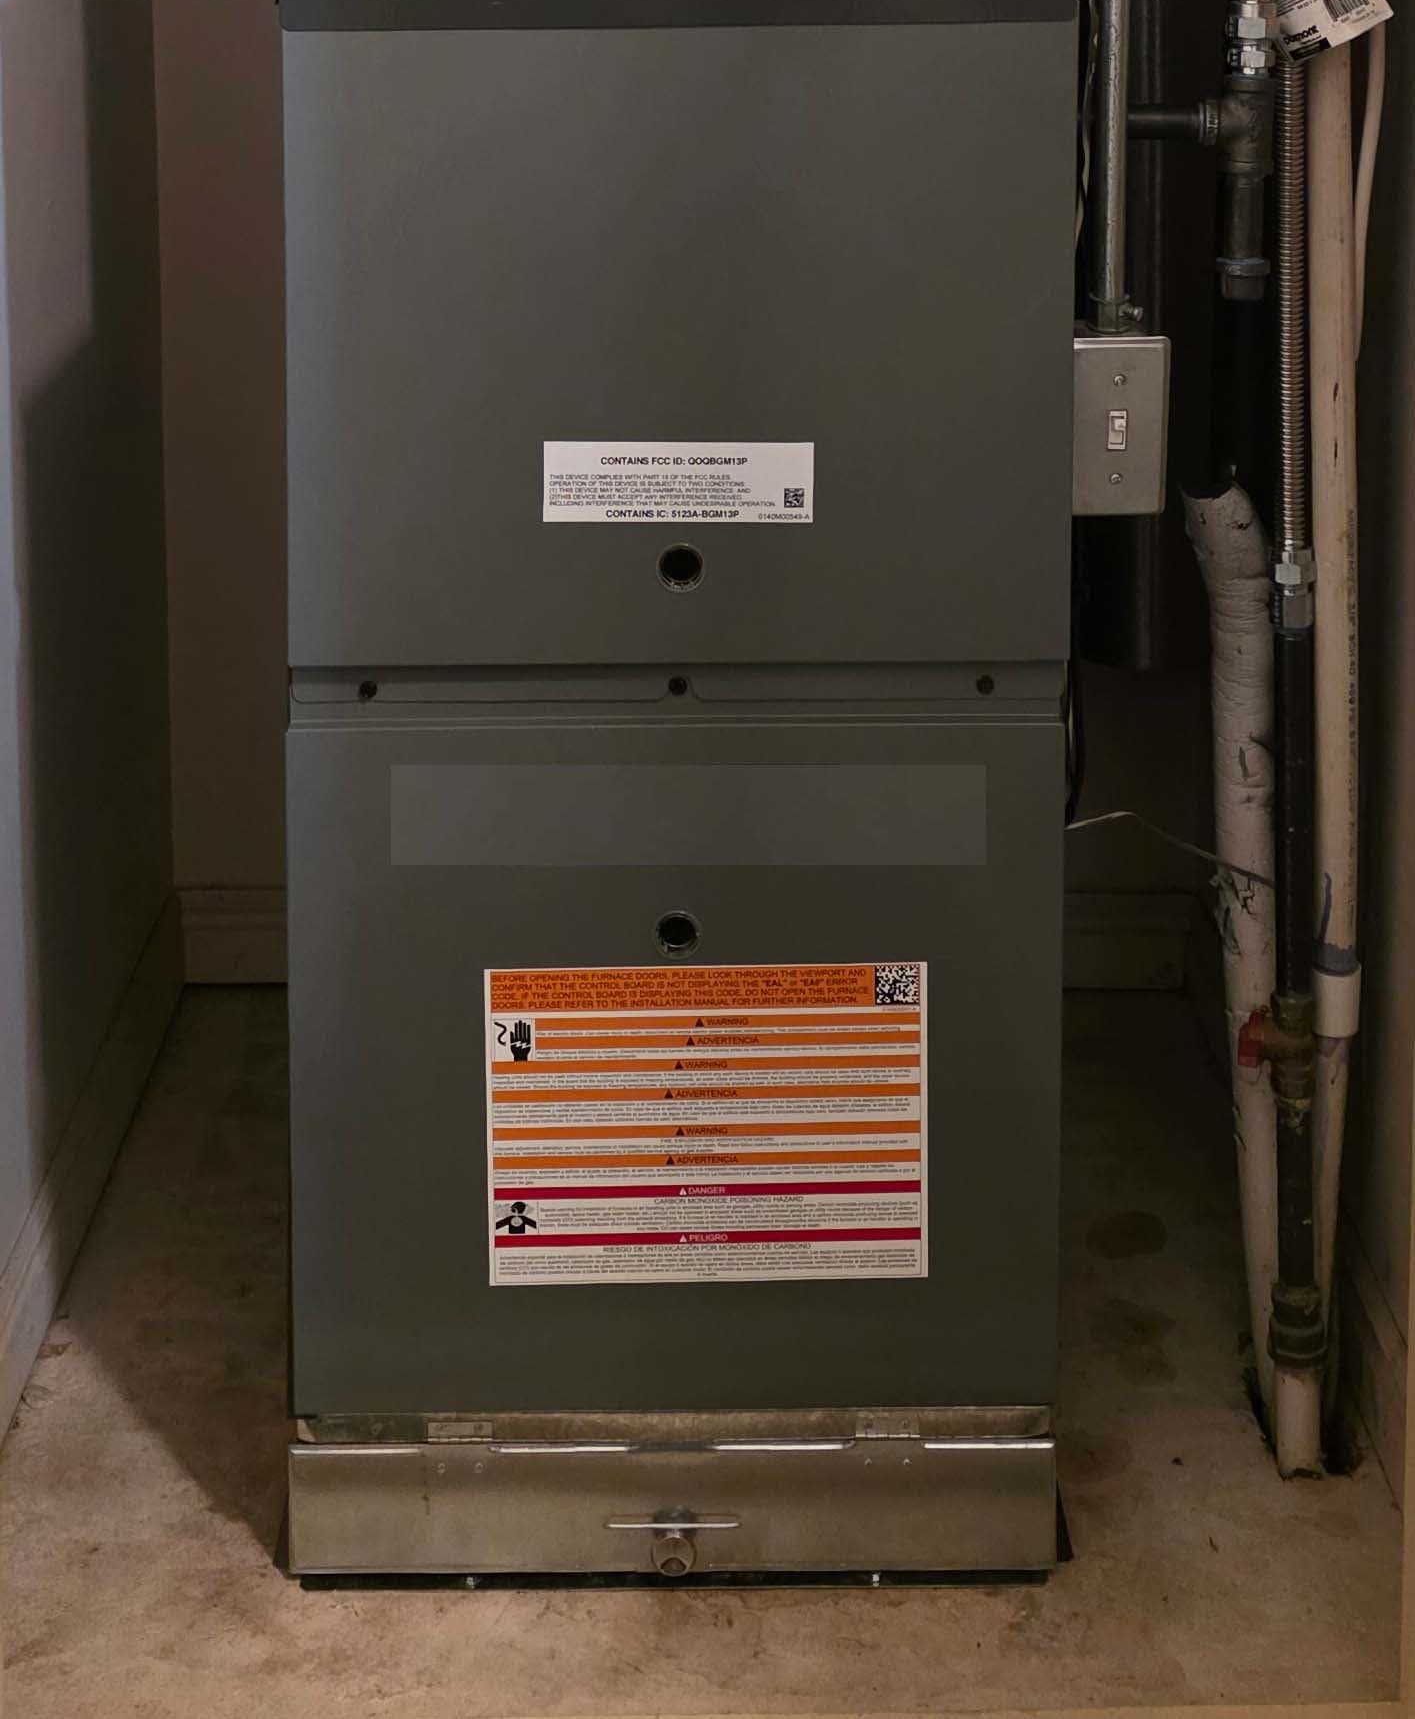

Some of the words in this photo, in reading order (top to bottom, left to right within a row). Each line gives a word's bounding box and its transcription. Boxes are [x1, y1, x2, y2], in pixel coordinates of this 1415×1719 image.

[600, 457, 649, 465] CONTAINS
[652, 457, 671, 465] FCC
[673, 457, 685, 465] ID:
[606, 510, 654, 518] CONTAINS
[657, 510, 669, 518] IC:
[706, 1018, 749, 1026] WARNING
[697, 1036, 760, 1045] ADVERTENCIA
[685, 1061, 728, 1069] WARNING
[675, 1090, 738, 1098] ADVERTENCIA
[686, 1127, 728, 1135] WARNING
[676, 1155, 738, 1164] ADVERTENCIA
[688, 1187, 725, 1195] DANGER
[689, 1234, 728, 1242] PELIGRO
